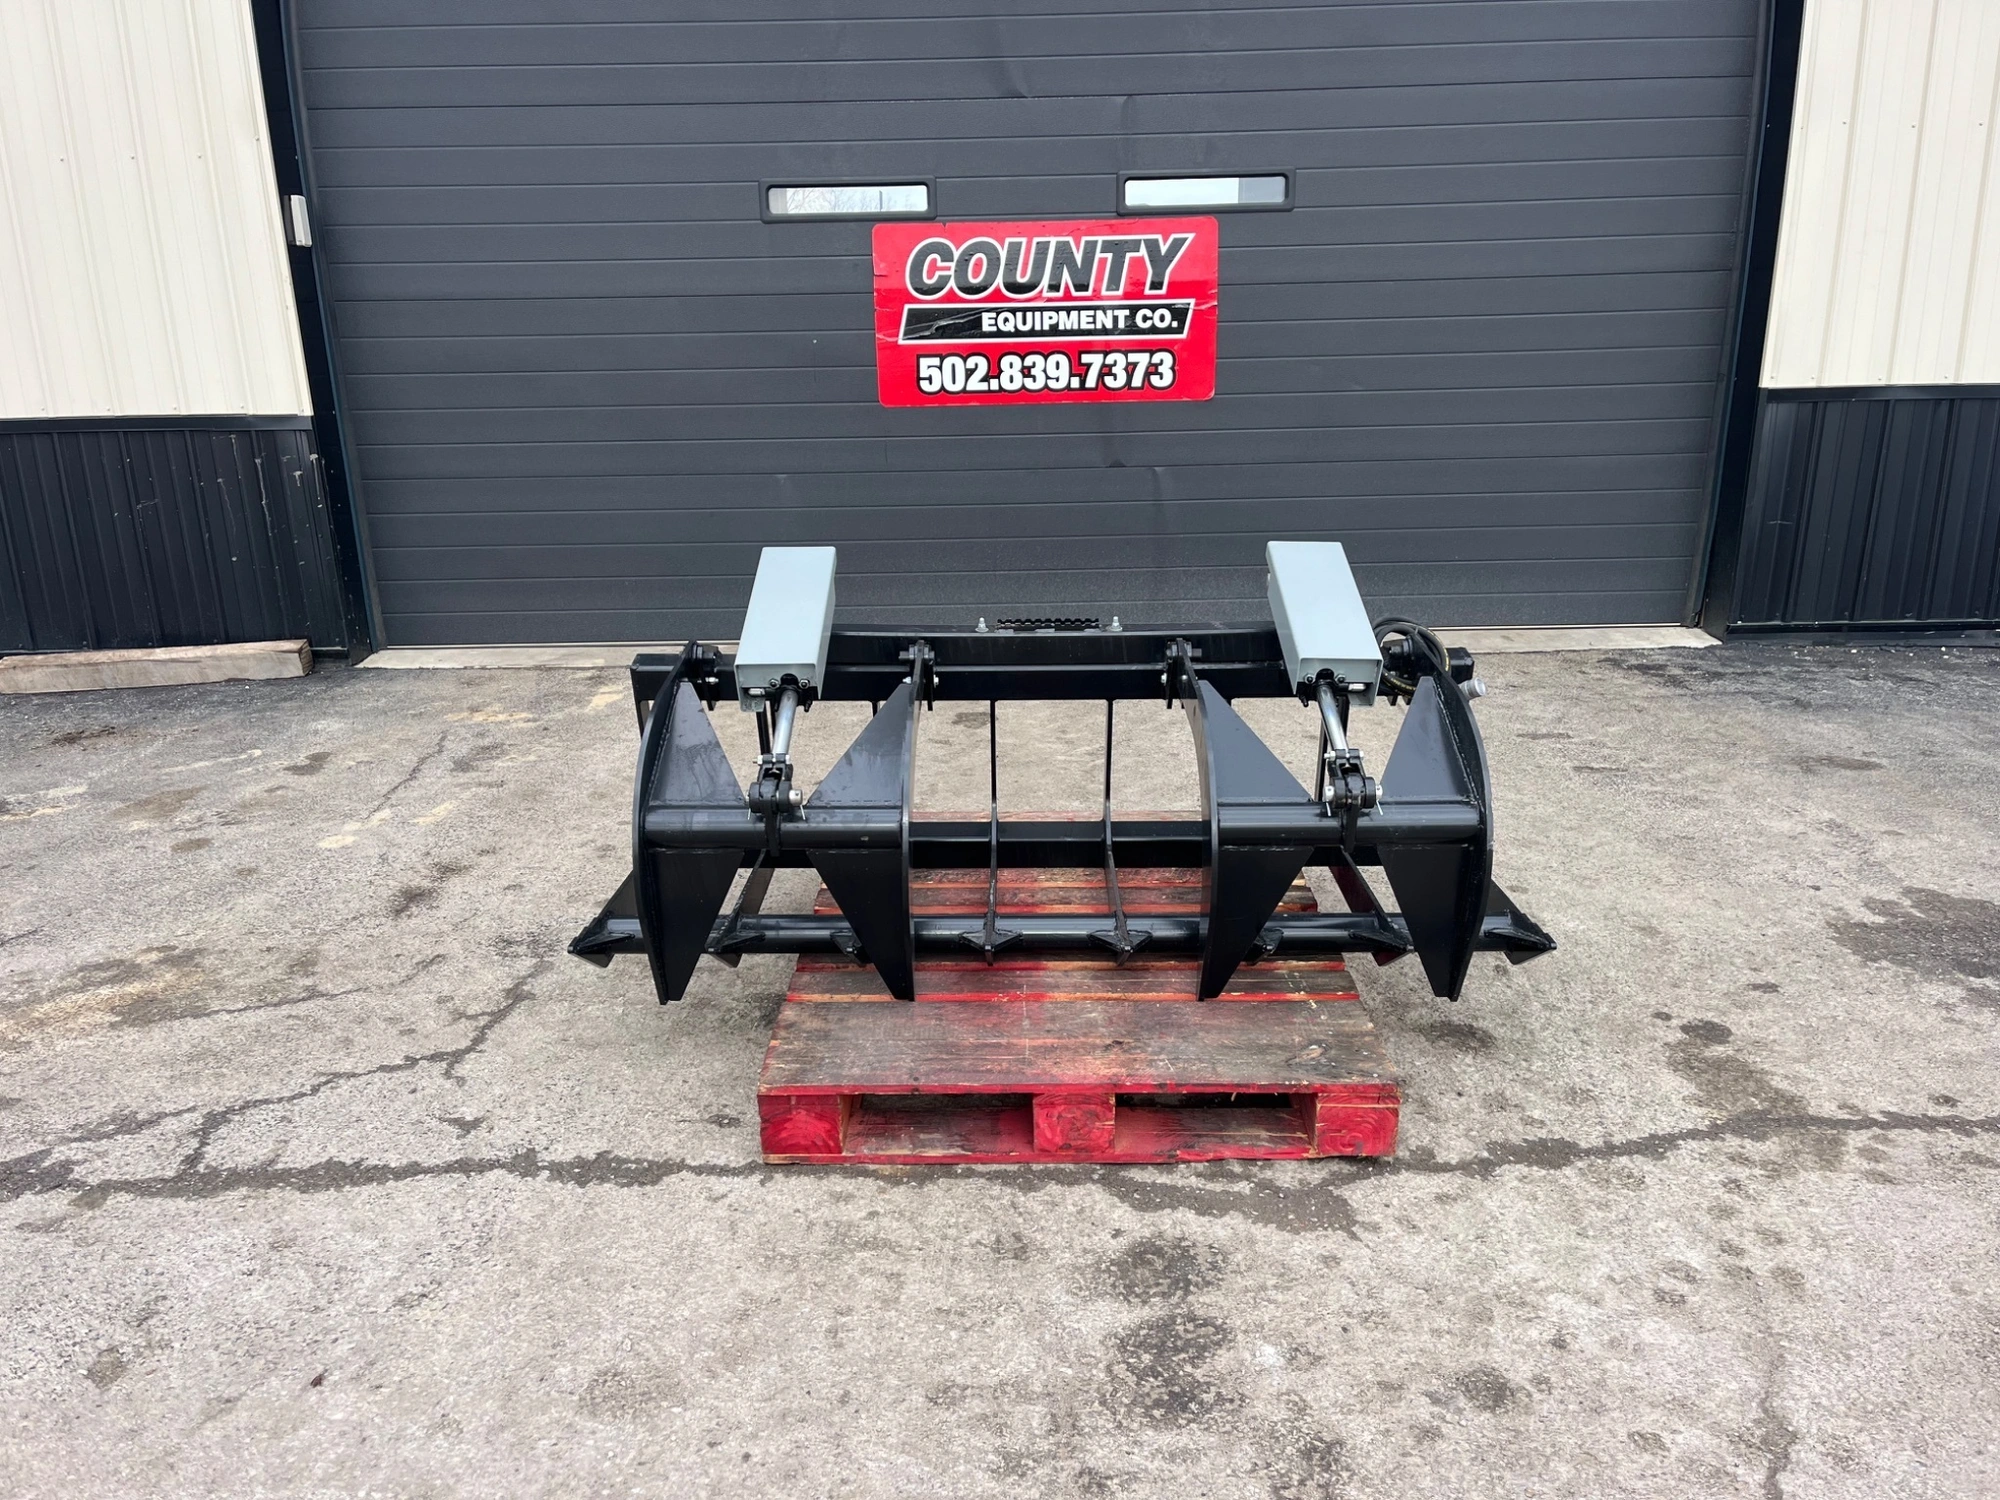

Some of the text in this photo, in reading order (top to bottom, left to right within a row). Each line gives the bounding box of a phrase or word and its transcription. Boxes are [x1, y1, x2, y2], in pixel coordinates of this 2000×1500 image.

[905, 233, 1196, 300] COUNTY
[982, 308, 1178, 333] EQUIPMENT CO.
[918, 350, 1175, 394] 502.839.7373
